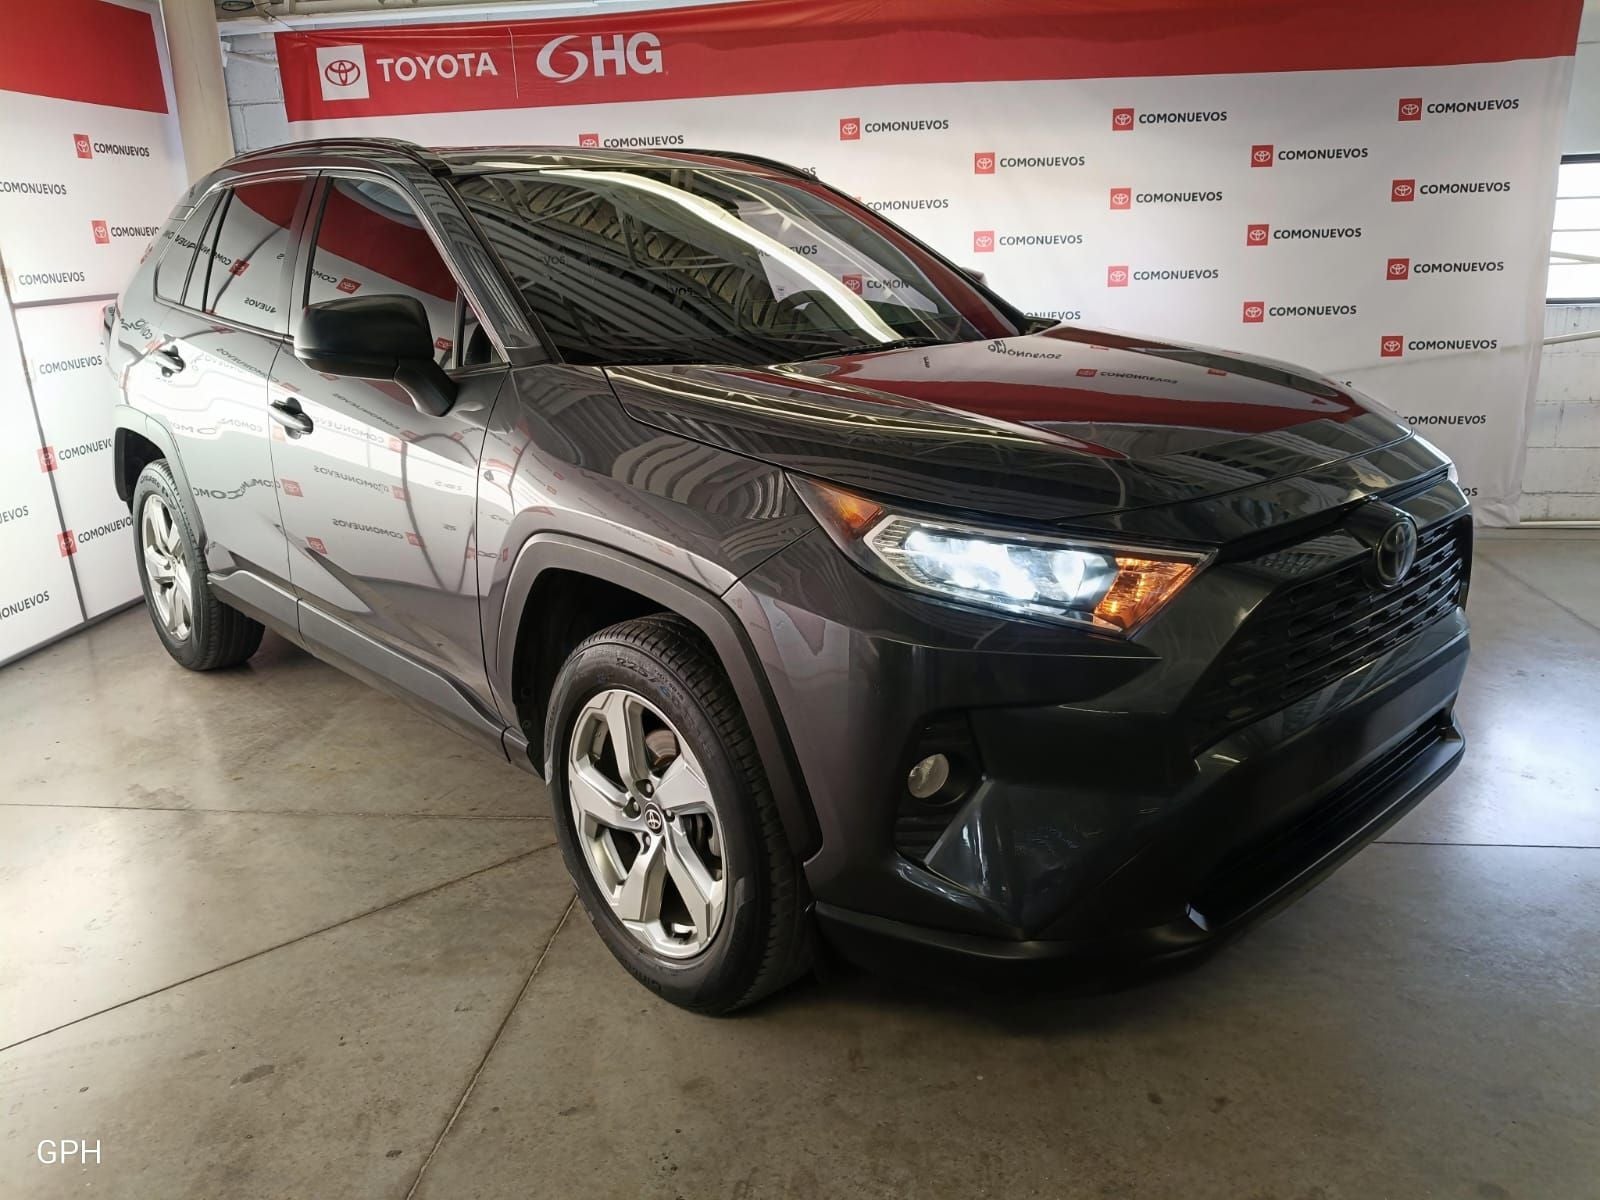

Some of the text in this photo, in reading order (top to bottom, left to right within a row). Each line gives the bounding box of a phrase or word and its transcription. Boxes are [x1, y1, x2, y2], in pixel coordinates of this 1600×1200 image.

[376, 52, 498, 83] TOYOTA
[1426, 98, 1520, 115] COMONUEVOS
[1138, 111, 1228, 124] COMONUEVOS
[864, 119, 950, 133] COMONUEVOS
[603, 135, 684, 149] COMONUEVOS
[93, 142, 150, 158] COMONUEVOS
[1278, 147, 1369, 161] COMONUEVOS
[999, 155, 1086, 169] COMONUEVOS
[1419, 181, 1511, 195] COMONUEVOS
[1135, 191, 1223, 204] COMONUEVOS
[999, 234, 1083, 247] COMONUEVOS
[1272, 227, 1362, 241] COMONUEVOS
[1413, 260, 1505, 274] COMONUEVOS
[18, 270, 86, 286] COMONUEVOS
[1133, 268, 1219, 282] COMONUEVOS
[1268, 304, 1358, 318] COMONUEVOS
[1408, 339, 1498, 351] COMONUEVOS
[39, 355, 103, 375] COMONUEVOS
[77, 516, 133, 544] COMONUEVO
